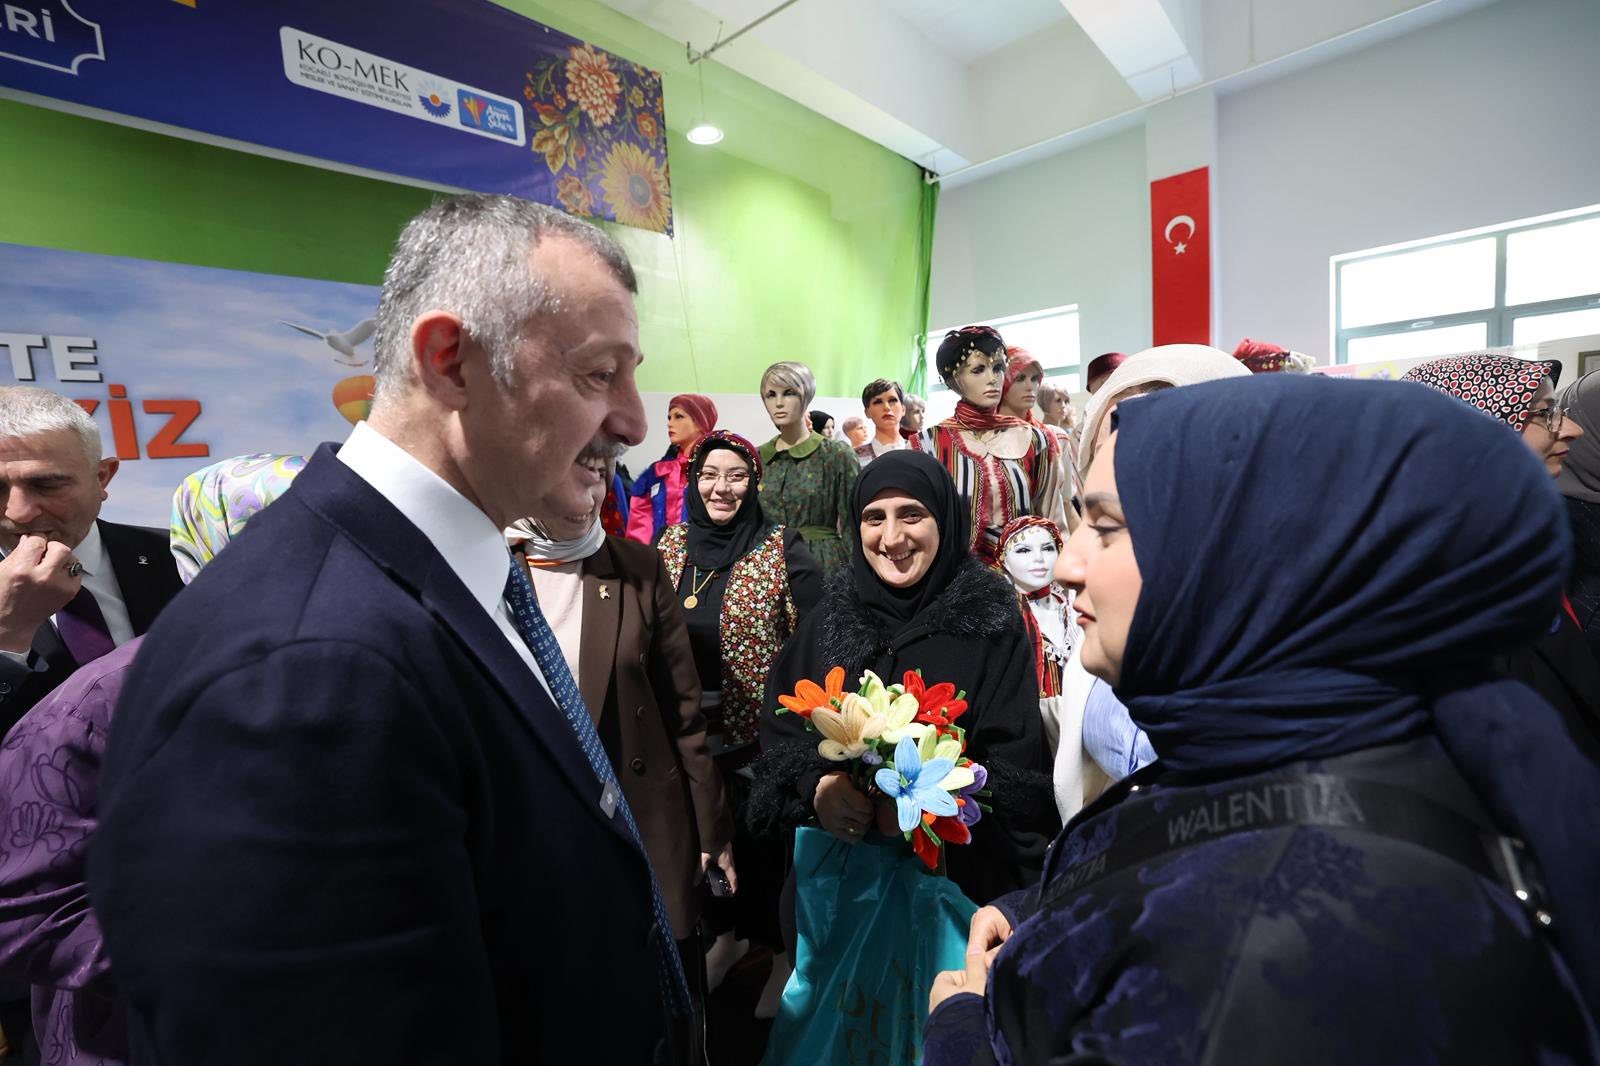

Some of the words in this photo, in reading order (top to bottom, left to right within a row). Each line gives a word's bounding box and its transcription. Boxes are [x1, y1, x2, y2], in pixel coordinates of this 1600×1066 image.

[0, 4, 55, 42] Rİ
[298, 39, 410, 92] KO-MEK
[73, 384, 209, 460] İZ
